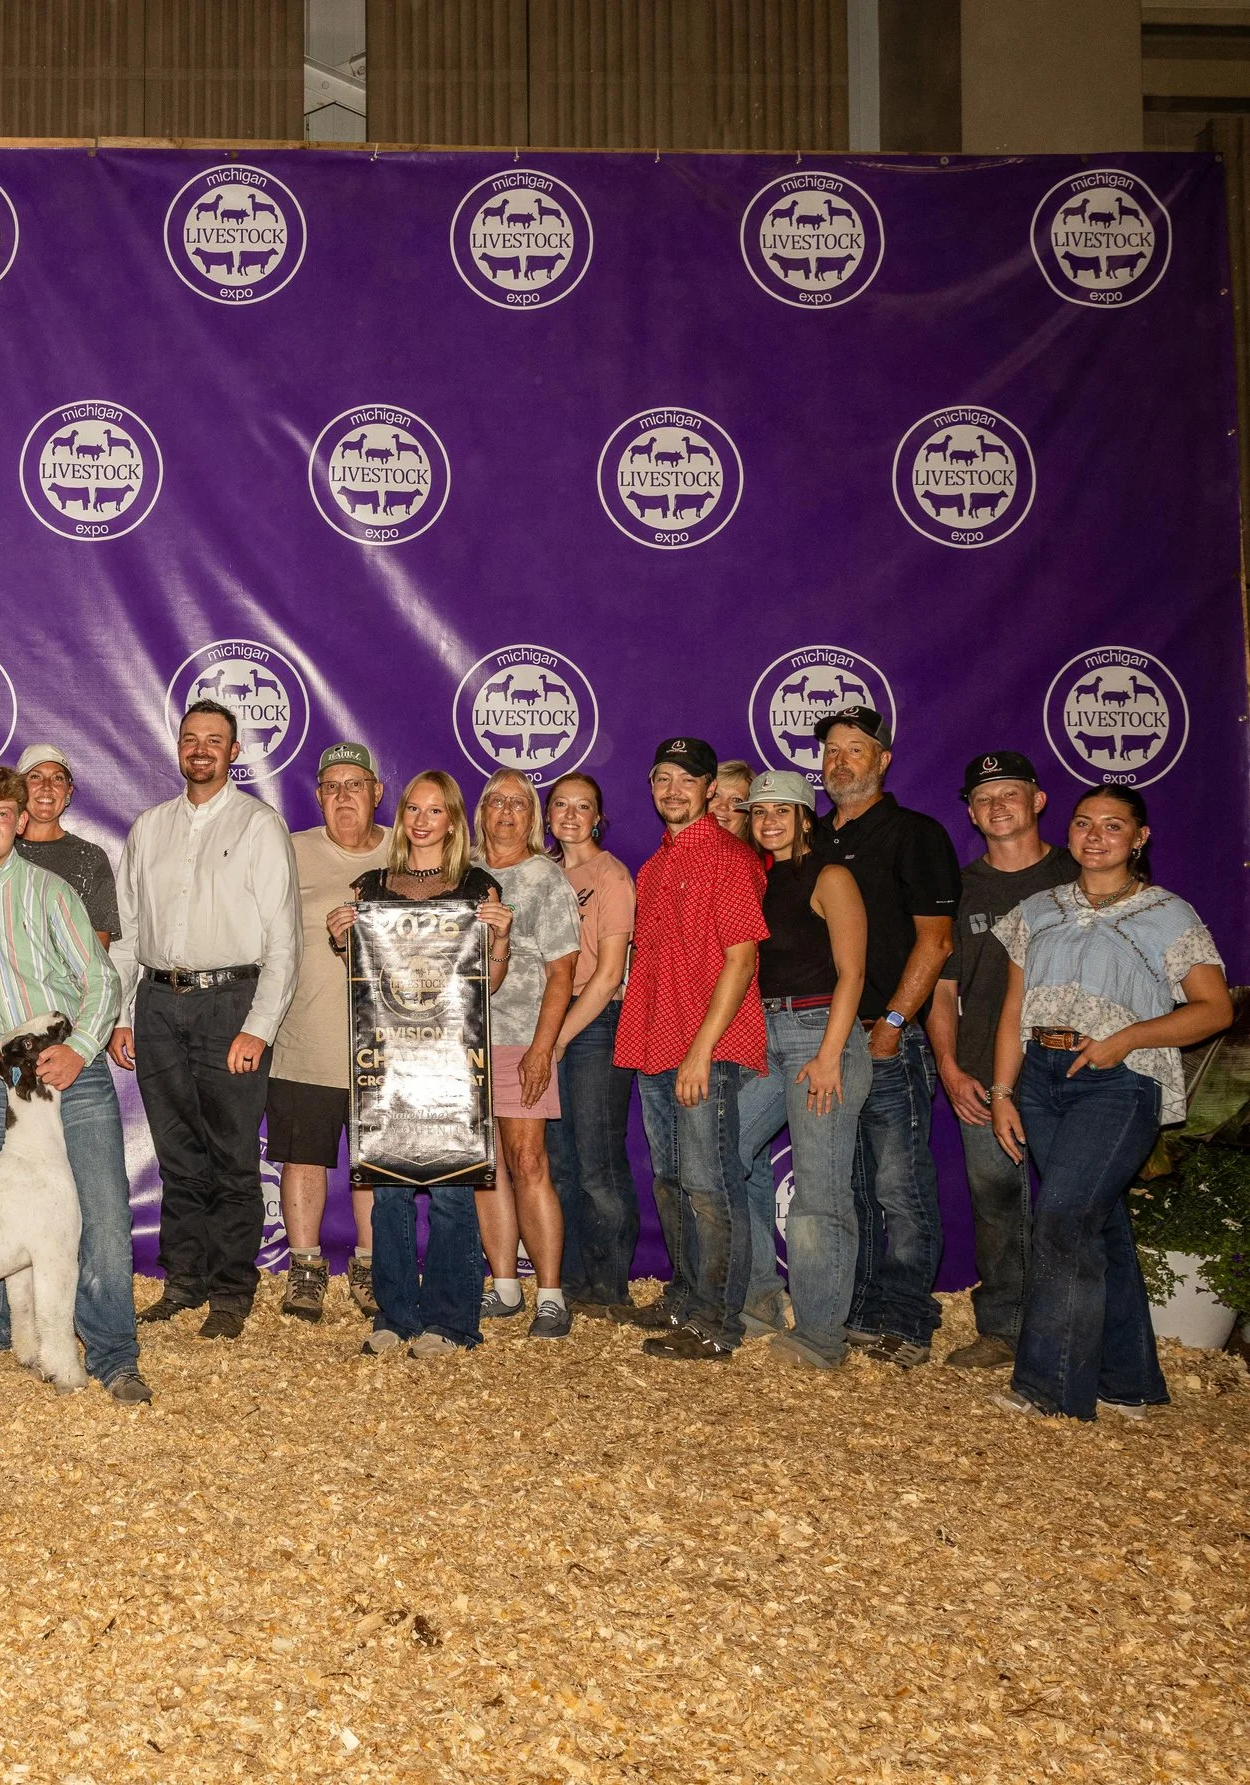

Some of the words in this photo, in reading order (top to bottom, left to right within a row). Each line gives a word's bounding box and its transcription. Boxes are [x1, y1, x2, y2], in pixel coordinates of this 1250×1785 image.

[206, 168, 268, 188] michigan
[492, 173, 554, 192] michigan
[780, 175, 844, 194] michigan
[1070, 173, 1134, 192] michigan
[186, 228, 285, 244] LIVESTOCK
[472, 233, 572, 249] LIVESTOCK
[762, 234, 862, 250] LIVESTOCK
[1053, 232, 1152, 249] LIVESTOCK
[220, 289, 253, 302] expo
[507, 294, 540, 307] expo
[799, 293, 832, 306] expo
[1090, 292, 1122, 304] expo
[61, 406, 123, 425] michigan
[350, 410, 411, 429] michigan
[639, 413, 702, 432] michigan
[933, 409, 997, 428] michigan
[41, 463, 141, 481] LIVESTOCK
[331, 466, 429, 485] LIVESTOCK
[619, 472, 721, 487] LIVESTOCK
[914, 470, 1015, 486] LIVESTOCK
[76, 525, 108, 537] expo
[365, 527, 399, 540] expo
[655, 533, 688, 545] expo
[951, 531, 983, 544] expo
[206, 646, 271, 664] michigan
[496, 651, 558, 670] michigan
[790, 649, 855, 668] michigan
[1084, 653, 1149, 672] michigan
[474, 710, 576, 727] LIVESTOCK
[1066, 712, 1167, 728] LIVESTOCK
[228, 767, 256, 780] xpo
[805, 772, 823, 784] ex
[1103, 774, 1136, 786] expo
[375, 1026, 448, 1041] DIVISION
